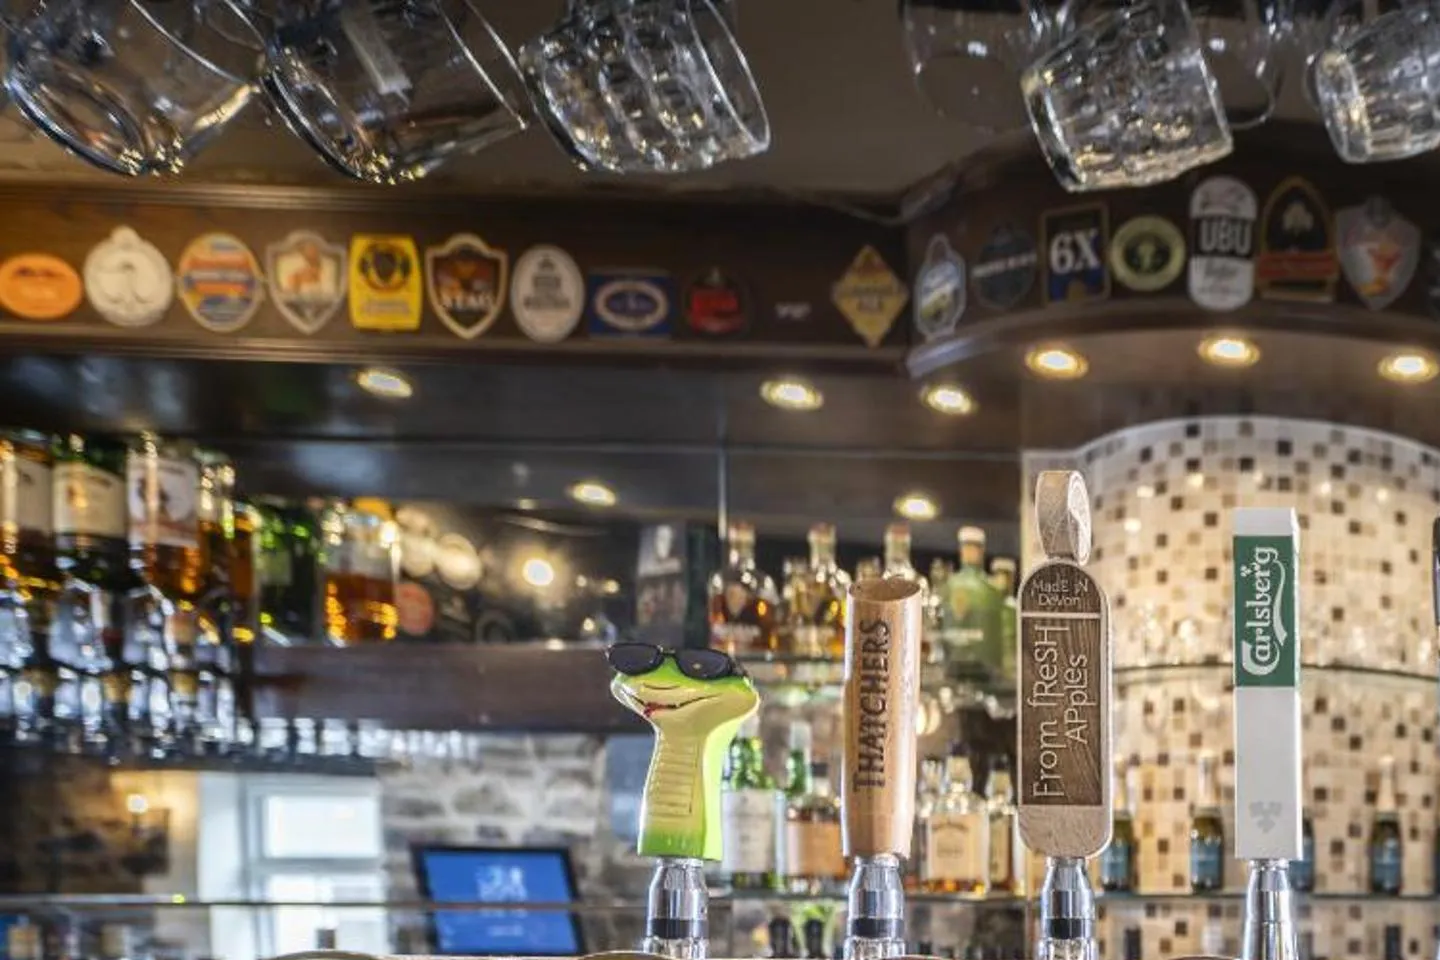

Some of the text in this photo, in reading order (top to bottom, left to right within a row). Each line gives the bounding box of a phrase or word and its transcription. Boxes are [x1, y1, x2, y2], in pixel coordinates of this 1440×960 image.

[1049, 228, 1101, 274] 6X
[1200, 219, 1253, 256] UBU
[1241, 546, 1284, 676] Carlsberg
[853, 617, 891, 793] THATCHERS
